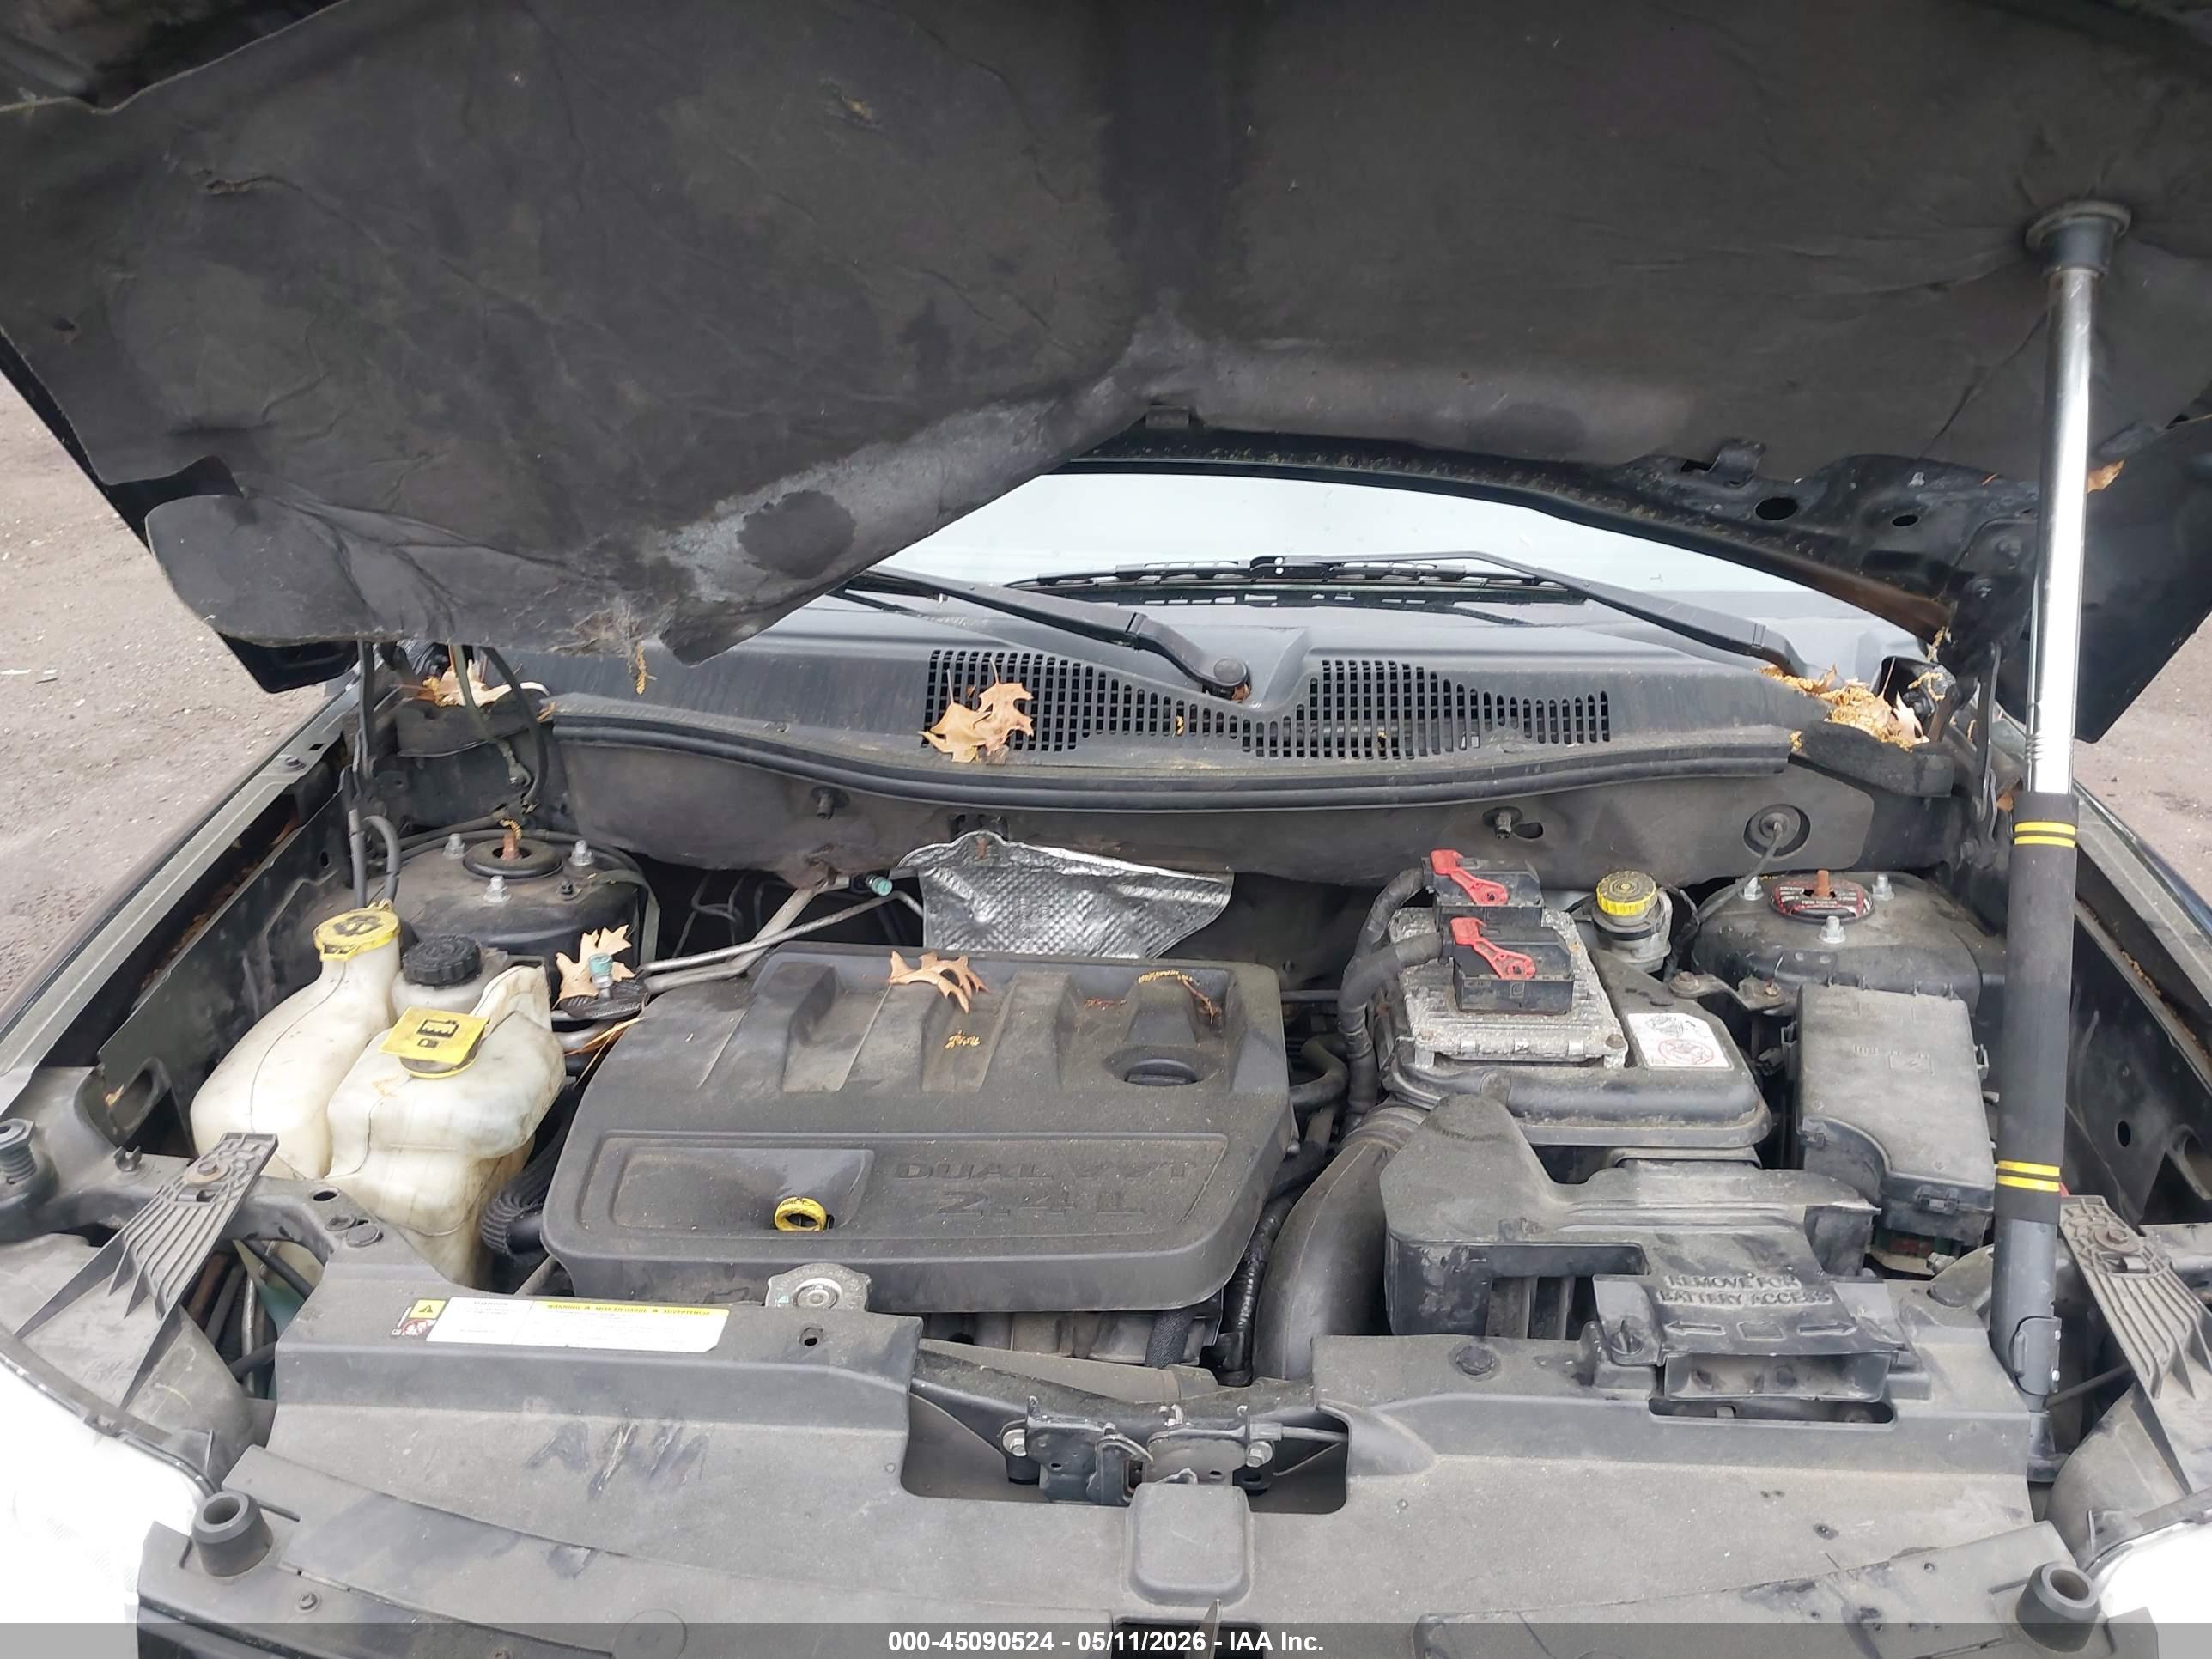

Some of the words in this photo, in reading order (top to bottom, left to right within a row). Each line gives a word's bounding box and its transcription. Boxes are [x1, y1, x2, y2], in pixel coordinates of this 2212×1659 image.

[893, 1163, 1054, 1179] DUAL
[1666, 1274, 1753, 1289] REMOVE
[1756, 1275, 1800, 1288] FOR
[1659, 1290, 1743, 1306] BATTERY
[1749, 1291, 1832, 1305] ACCESS
